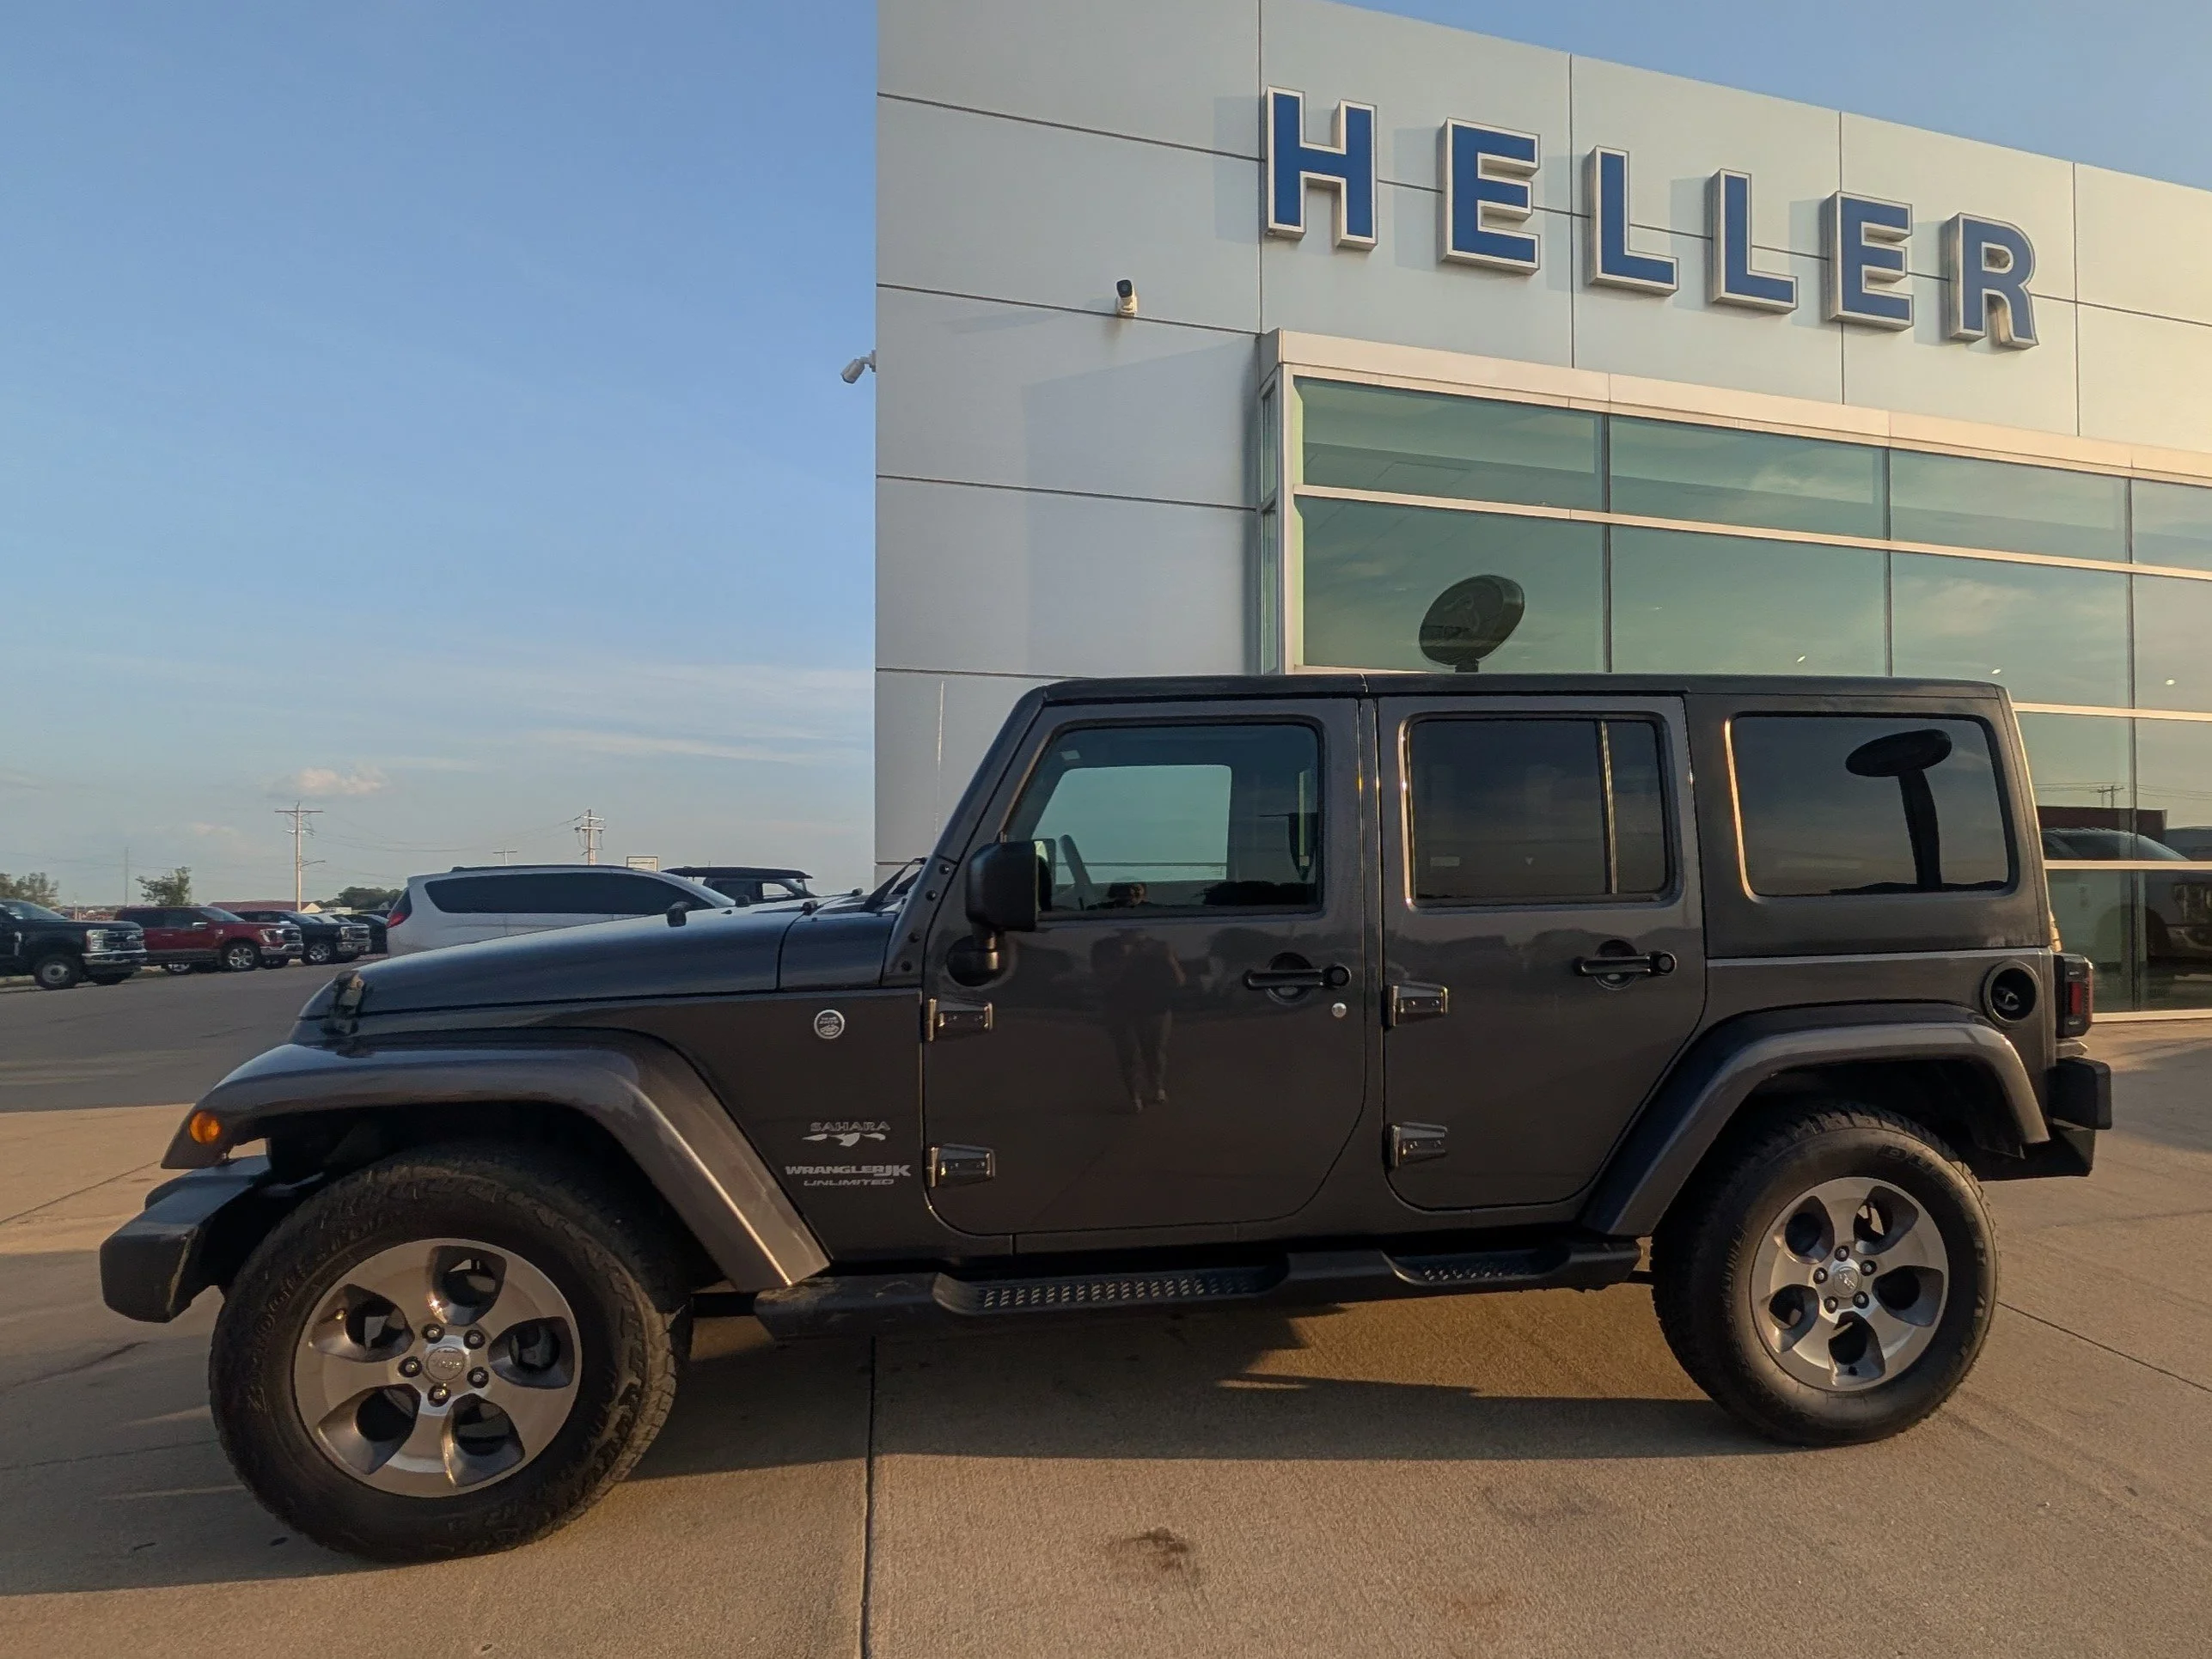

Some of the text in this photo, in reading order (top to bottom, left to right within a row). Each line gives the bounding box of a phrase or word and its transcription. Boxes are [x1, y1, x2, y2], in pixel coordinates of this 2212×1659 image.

[1264, 84, 2039, 349] HELLER
[810, 1120, 891, 1132] SAHARA
[803, 1178, 895, 1186] UNLIMITED
